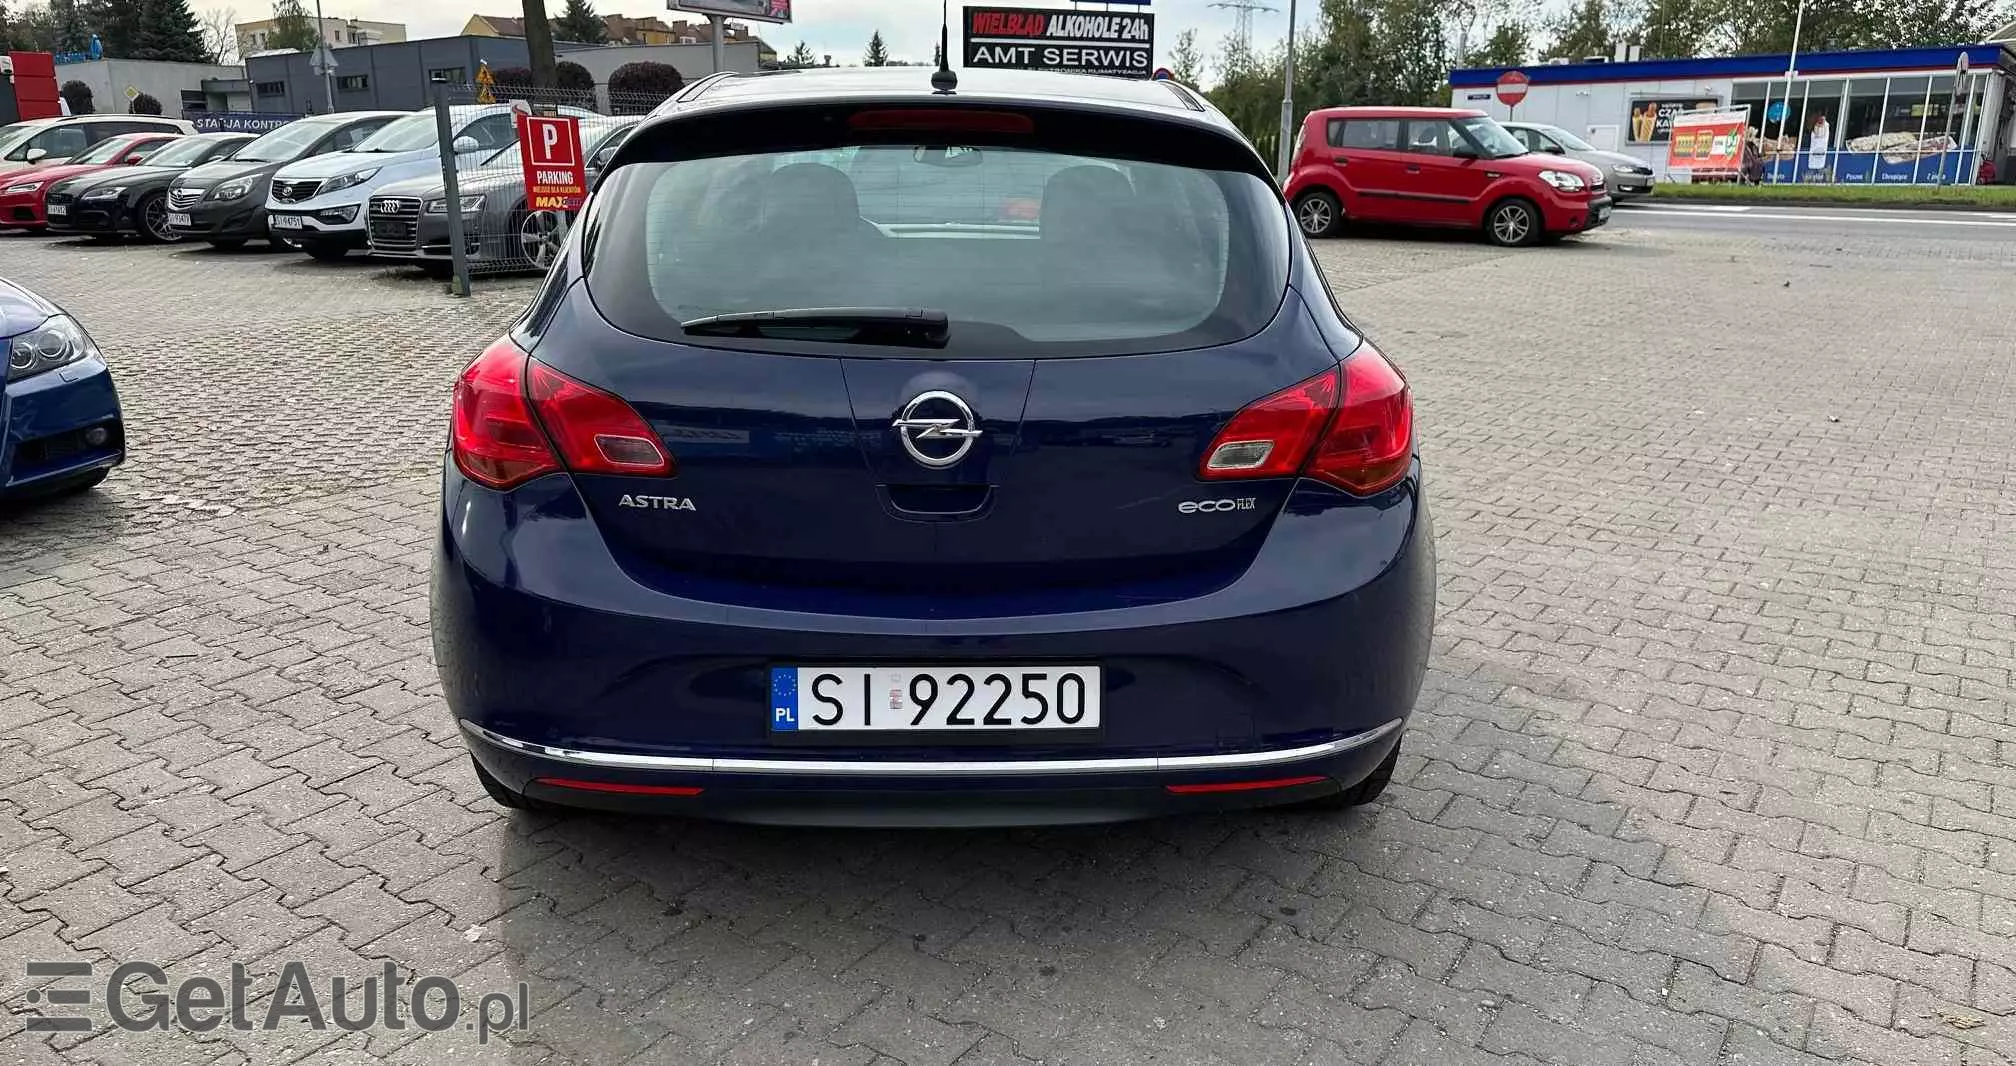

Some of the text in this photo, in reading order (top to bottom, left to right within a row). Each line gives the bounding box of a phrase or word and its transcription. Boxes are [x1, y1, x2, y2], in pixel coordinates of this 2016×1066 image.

[1046, 14, 1121, 39] ALKOHOLE
[1121, 17, 1149, 41] 24h
[973, 46, 1148, 68] AMT SERWIS
[542, 123, 558, 160] P
[536, 170, 574, 185] PARKING
[618, 494, 697, 511] ASTRA
[811, 672, 1086, 726] SI 92250
[775, 707, 795, 723] PL
